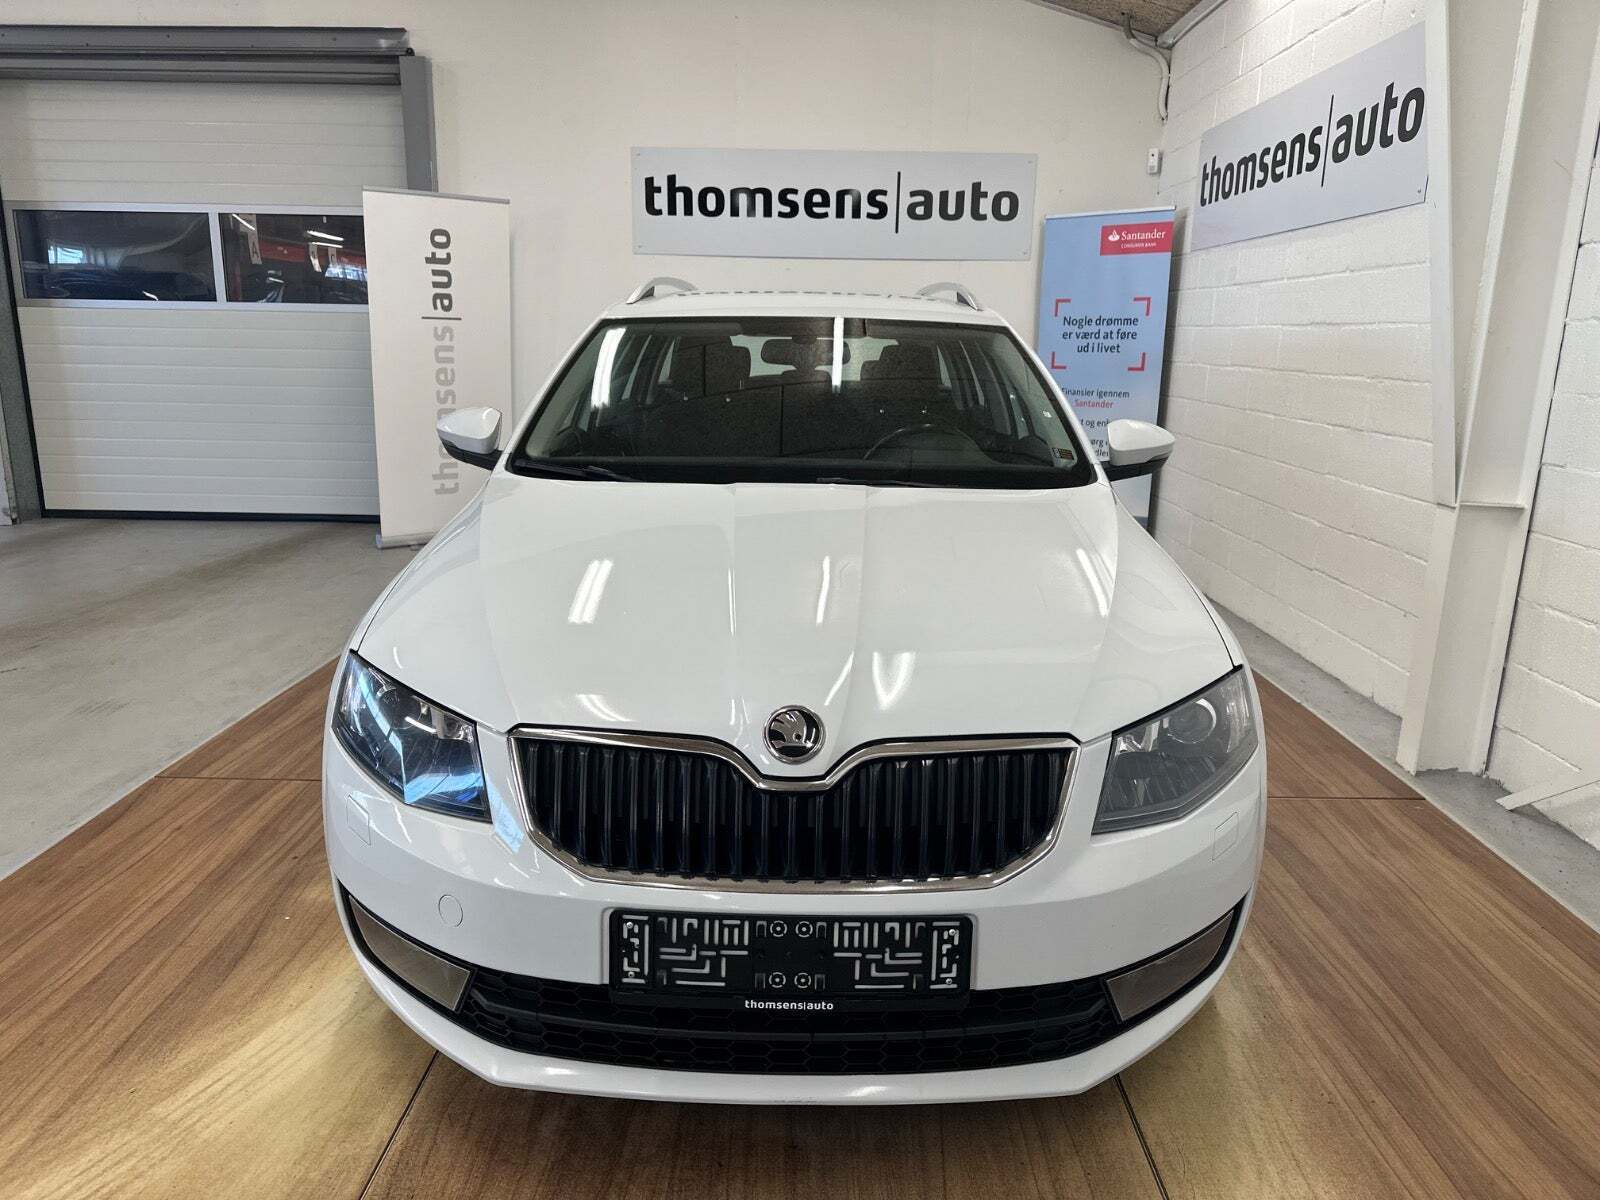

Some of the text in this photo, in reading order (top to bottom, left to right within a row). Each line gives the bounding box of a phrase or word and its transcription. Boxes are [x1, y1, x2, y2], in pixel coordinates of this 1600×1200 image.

[1121, 227, 1166, 241] Santander
[1063, 315, 1139, 329] Nogle drømme
[1062, 329, 1137, 340] er værd at føre
[1077, 342, 1121, 353] ud i livet
[1096, 386, 1130, 399] igennem
[1073, 399, 1114, 409] Santander
[1085, 419, 1096, 429] og
